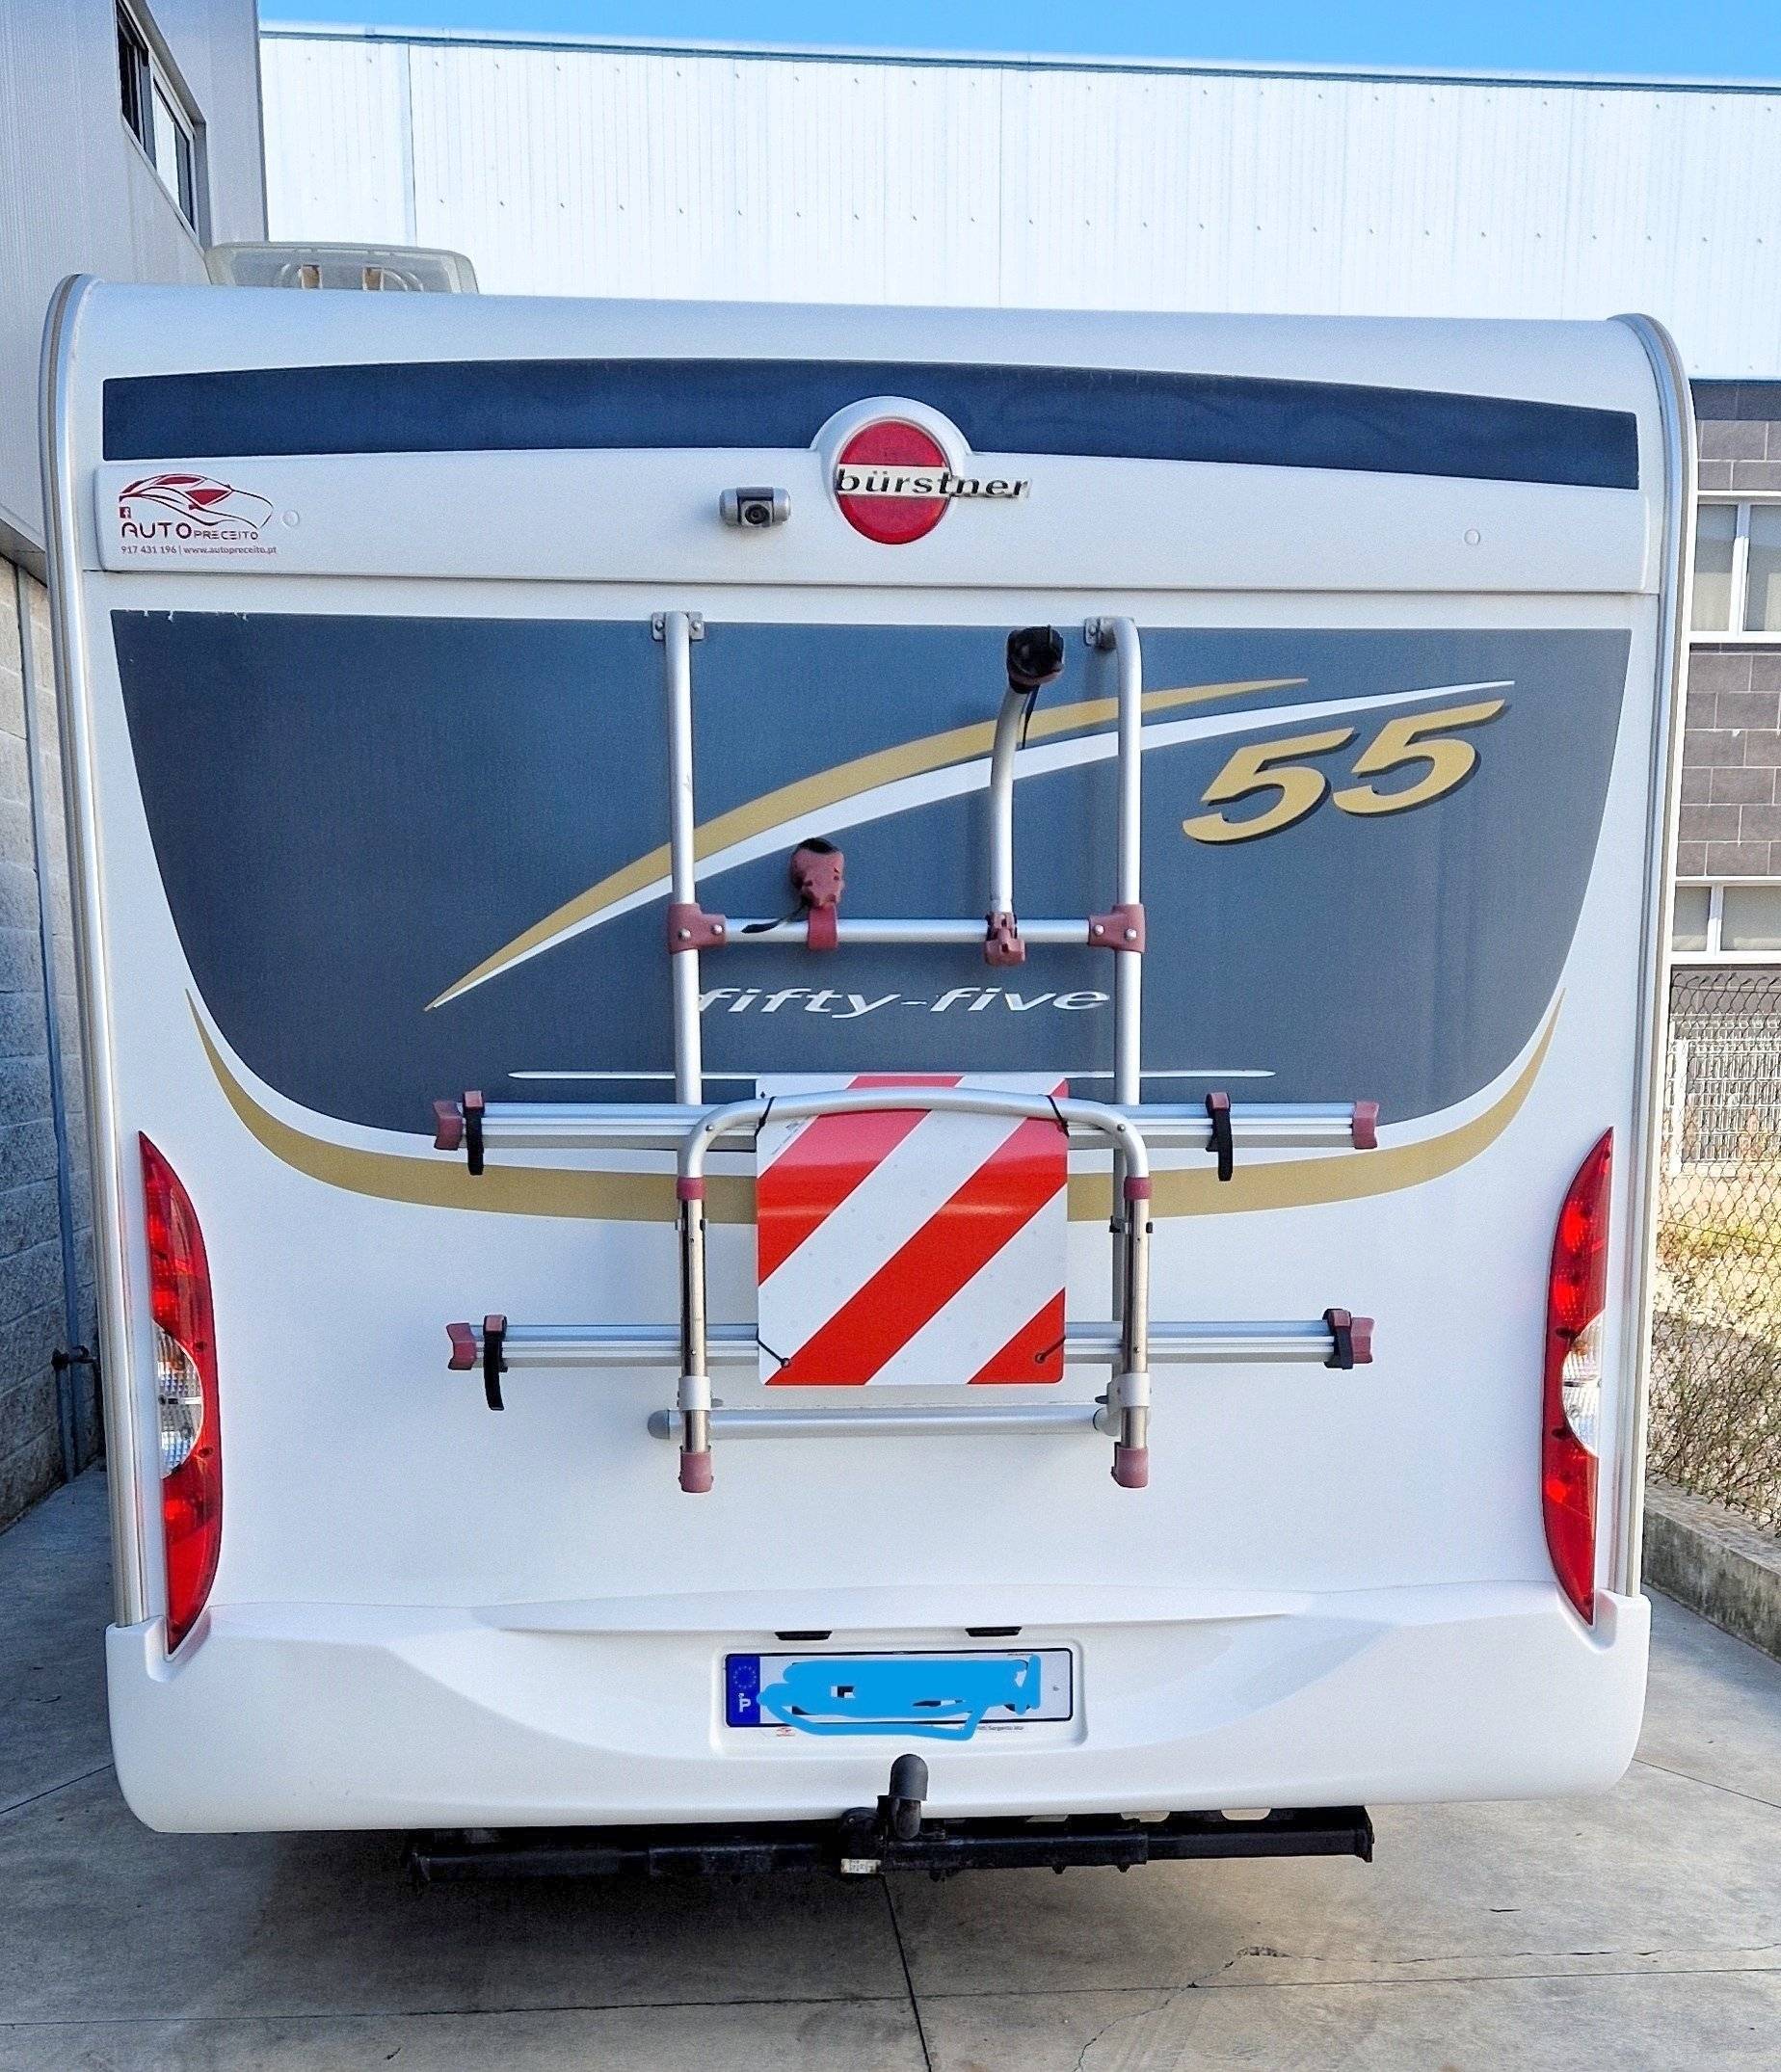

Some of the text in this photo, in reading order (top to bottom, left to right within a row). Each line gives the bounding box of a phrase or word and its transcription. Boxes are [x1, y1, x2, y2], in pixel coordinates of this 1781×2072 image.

[837, 468, 1028, 497] bürstner
[121, 545, 138, 554] 917
[141, 545, 157, 554] 431
[161, 545, 176, 554] 196
[183, 545, 277, 555] www.autopreceito.pt
[1182, 699, 1510, 845] 55
[699, 987, 1109, 1019] fifty-five
[739, 1698, 751, 1713] P
